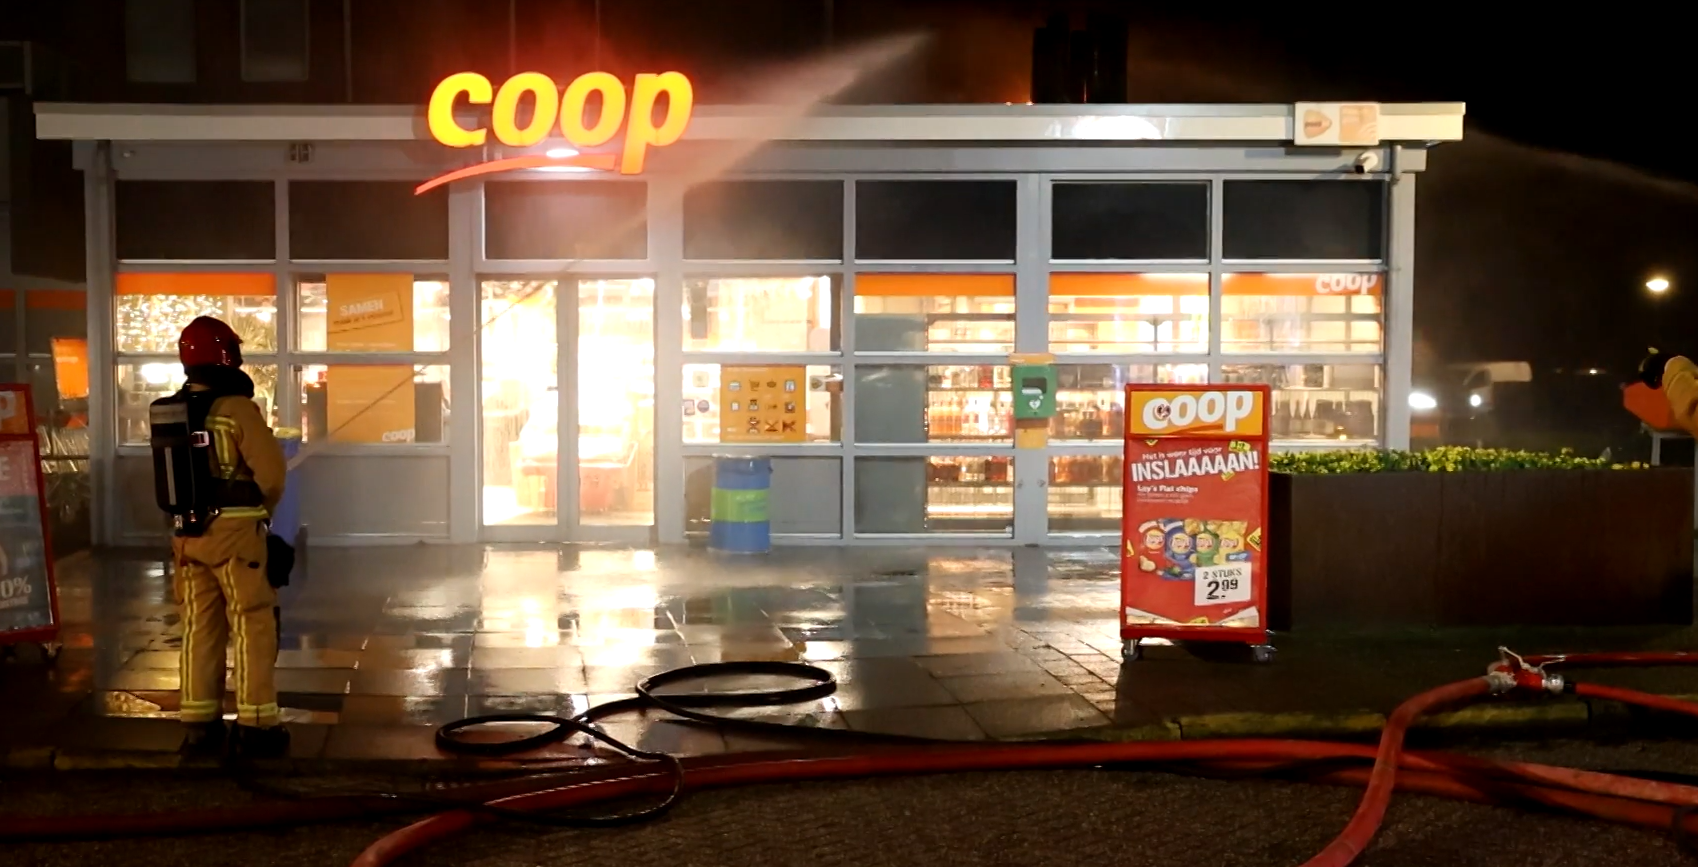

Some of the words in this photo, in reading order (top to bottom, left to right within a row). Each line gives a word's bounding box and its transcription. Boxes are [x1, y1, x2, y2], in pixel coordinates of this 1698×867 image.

[428, 71, 693, 175] coop
[1316, 272, 1377, 295] coop
[339, 299, 383, 316] SAMEN
[1142, 391, 1254, 432] coop
[382, 429, 415, 442] coop
[1131, 451, 1259, 481] INSLAAAAAN!
[1203, 571, 1209, 580] 2
[1212, 567, 1242, 578] STUKS
